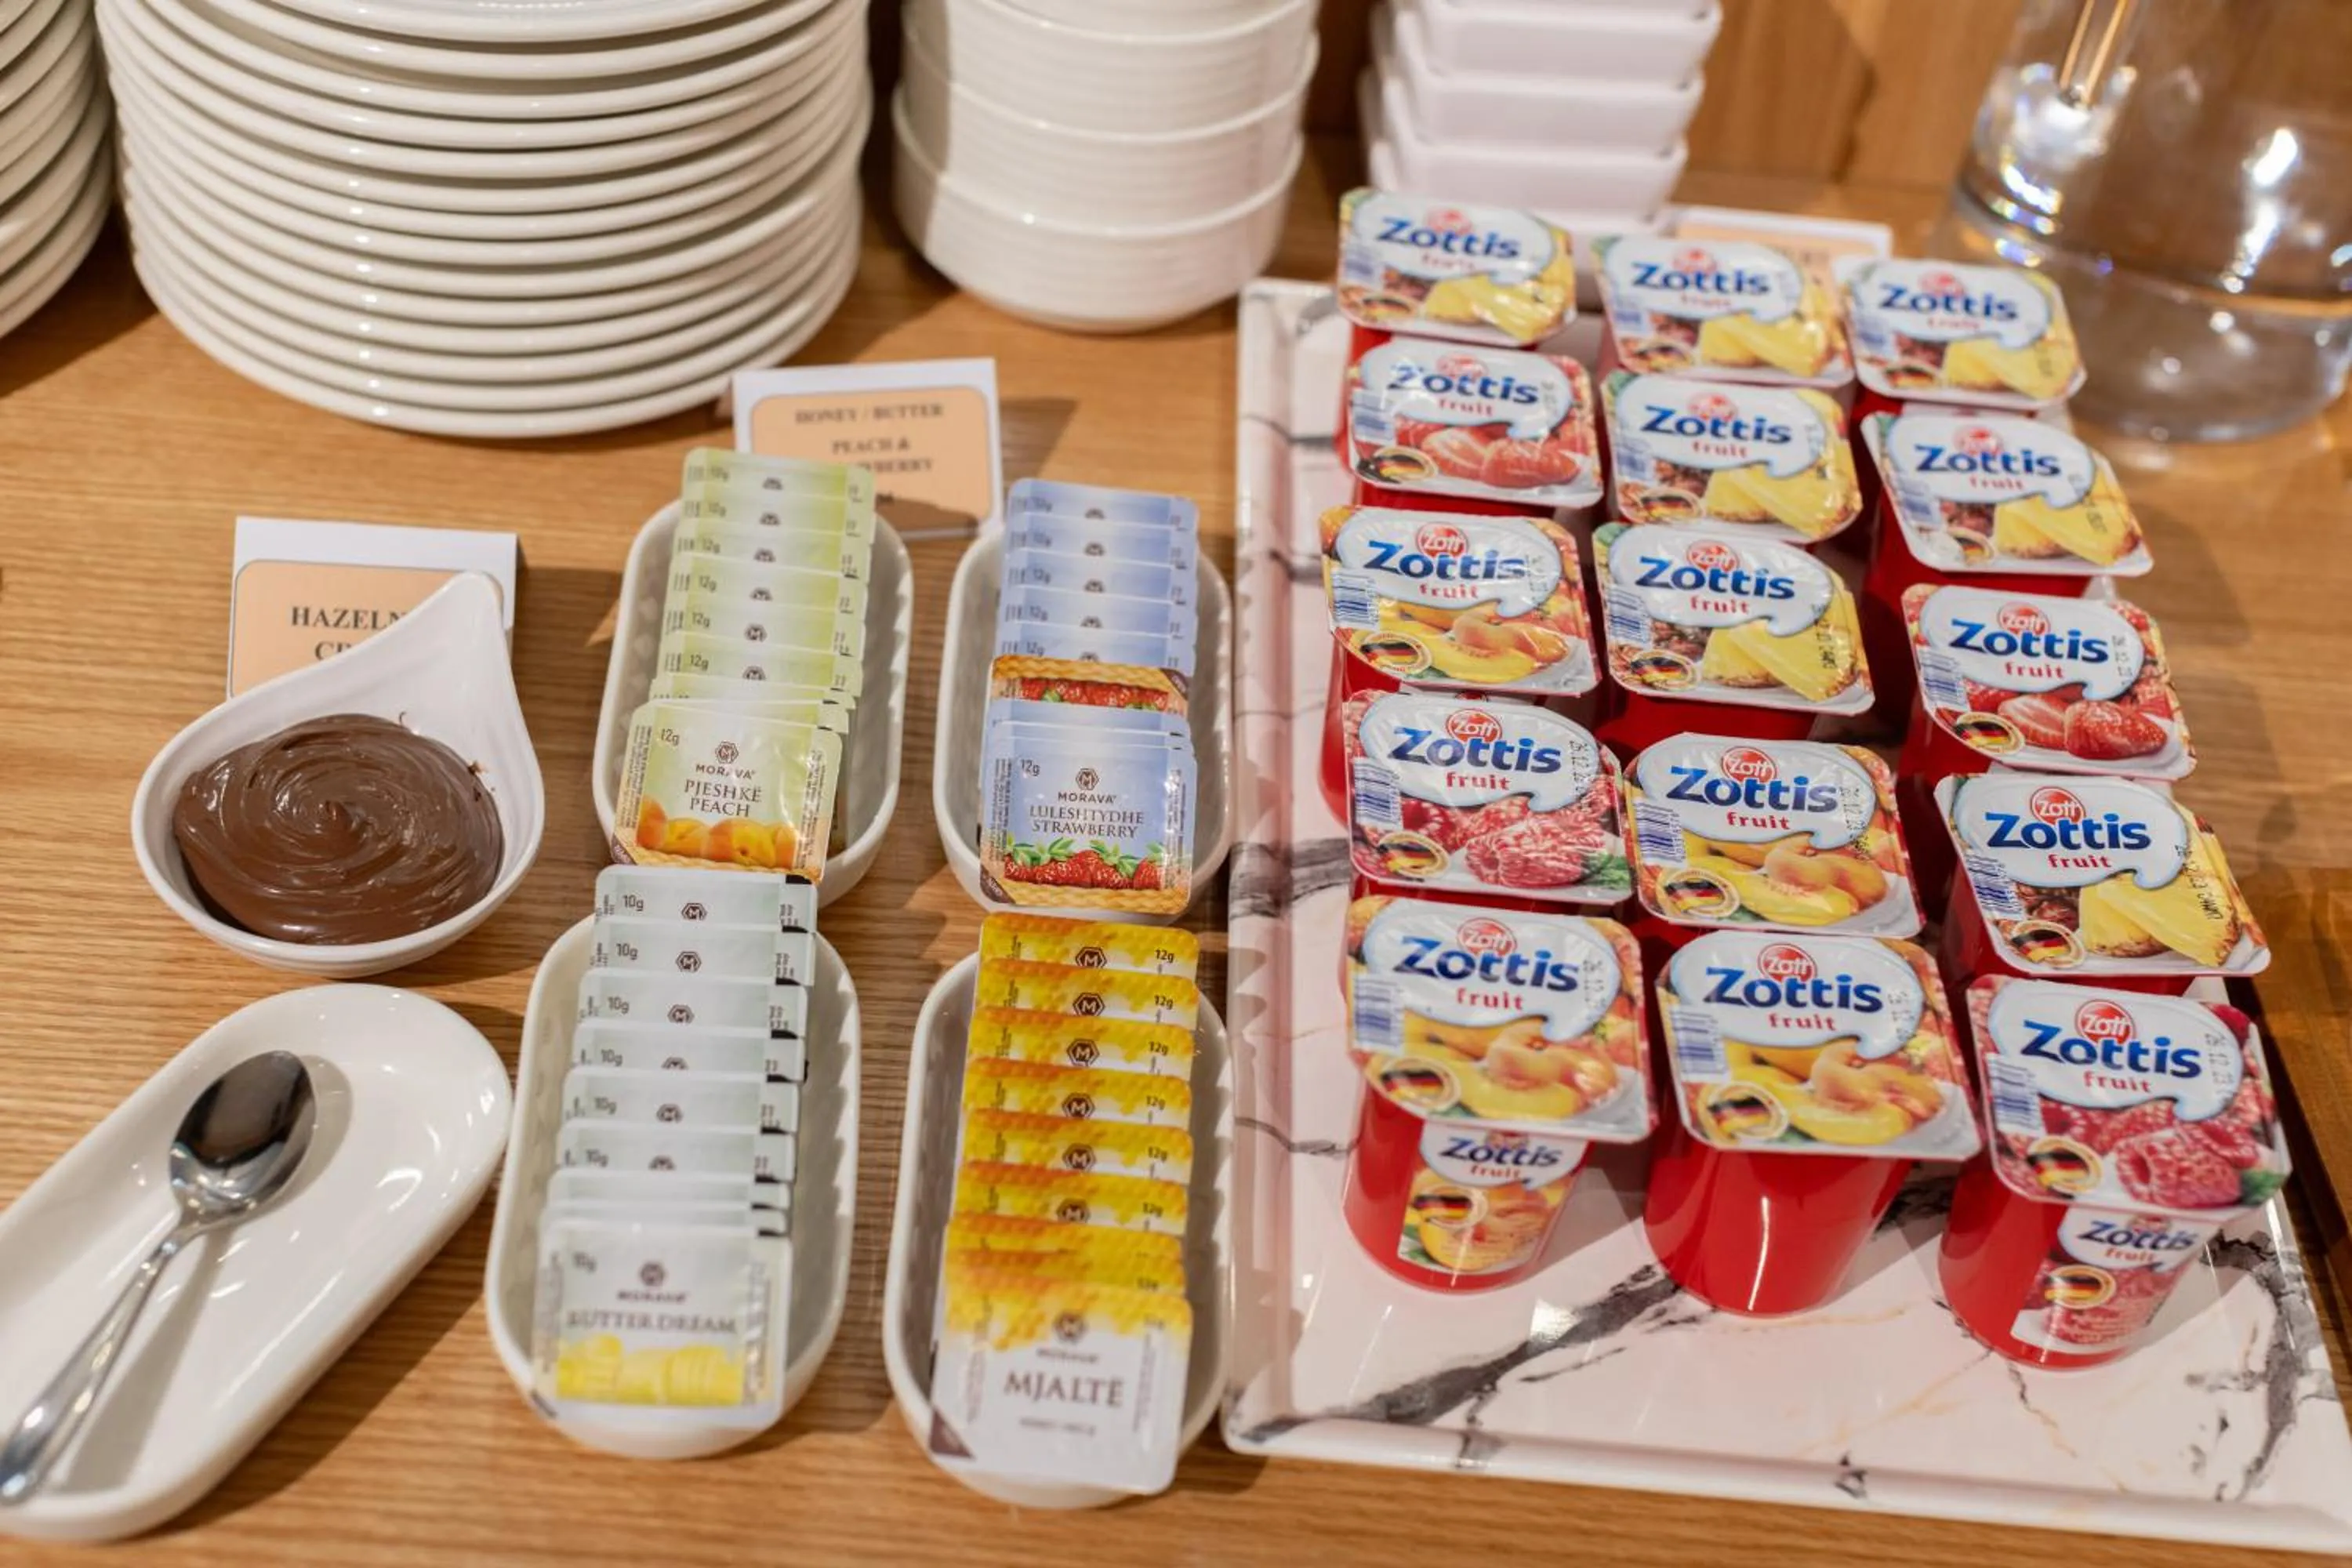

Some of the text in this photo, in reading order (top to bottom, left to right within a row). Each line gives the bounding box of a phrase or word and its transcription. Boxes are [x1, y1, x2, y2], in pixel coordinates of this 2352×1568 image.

[1377, 216, 1521, 258] Zottis
[1633, 263, 1769, 294] Zottis
[1880, 285, 2017, 320] Zottis
[1387, 366, 1538, 403] Zottis
[1641, 406, 1791, 444] Zottis
[1915, 445, 2061, 476] Zottis
[1365, 540, 1527, 580] Zottis
[1635, 556, 1795, 600] Zottis
[1418, 583, 1479, 598] fruit
[1690, 596, 1749, 614] fruit
[291, 606, 407, 630] HAZELN
[691, 612, 710, 629] 12g
[1949, 618, 2109, 663] Zottis
[689, 654, 709, 671] 12g
[2005, 661, 2064, 679] fruit
[660, 728, 680, 746] 12g
[1454, 717, 1496, 738] Zott
[1388, 728, 1561, 773] Zottis
[1020, 758, 1040, 776] 12g
[1730, 758, 1772, 776] Zott
[1445, 771, 1510, 790] fruit
[1667, 766, 1838, 812] Zottis
[690, 797, 750, 818] PEACH
[1058, 792, 1115, 805] MORAVA
[2038, 799, 2080, 817] Zott
[1029, 805, 1145, 825] LULESHTYDHE
[1726, 811, 1791, 830] fruit
[1032, 821, 1138, 839] STRAWBERRY
[1984, 811, 2151, 851] Zottis
[2048, 853, 2112, 869] fruit
[623, 895, 644, 912] 10g
[616, 943, 638, 960] 10g
[1155, 949, 1175, 964] 12g
[1394, 936, 1579, 992] Zottis
[1456, 987, 1524, 1011] fruit
[1704, 967, 1883, 1013] Zottis
[608, 996, 630, 1014] 10g
[1154, 995, 1174, 1009] 12g
[1767, 1013, 1836, 1031] fruit
[2084, 1014, 2131, 1035] Zott
[601, 1049, 622, 1066] 10g
[1148, 1041, 1169, 1056] 12g
[2020, 1019, 2201, 1079] Zottis
[2082, 1070, 2151, 1093] fruit
[1146, 1094, 1166, 1110] 12g
[1148, 1146, 1167, 1161] 12g
[1440, 1138, 1563, 1166] Zottis
[2078, 1221, 2197, 1250] Zottis
